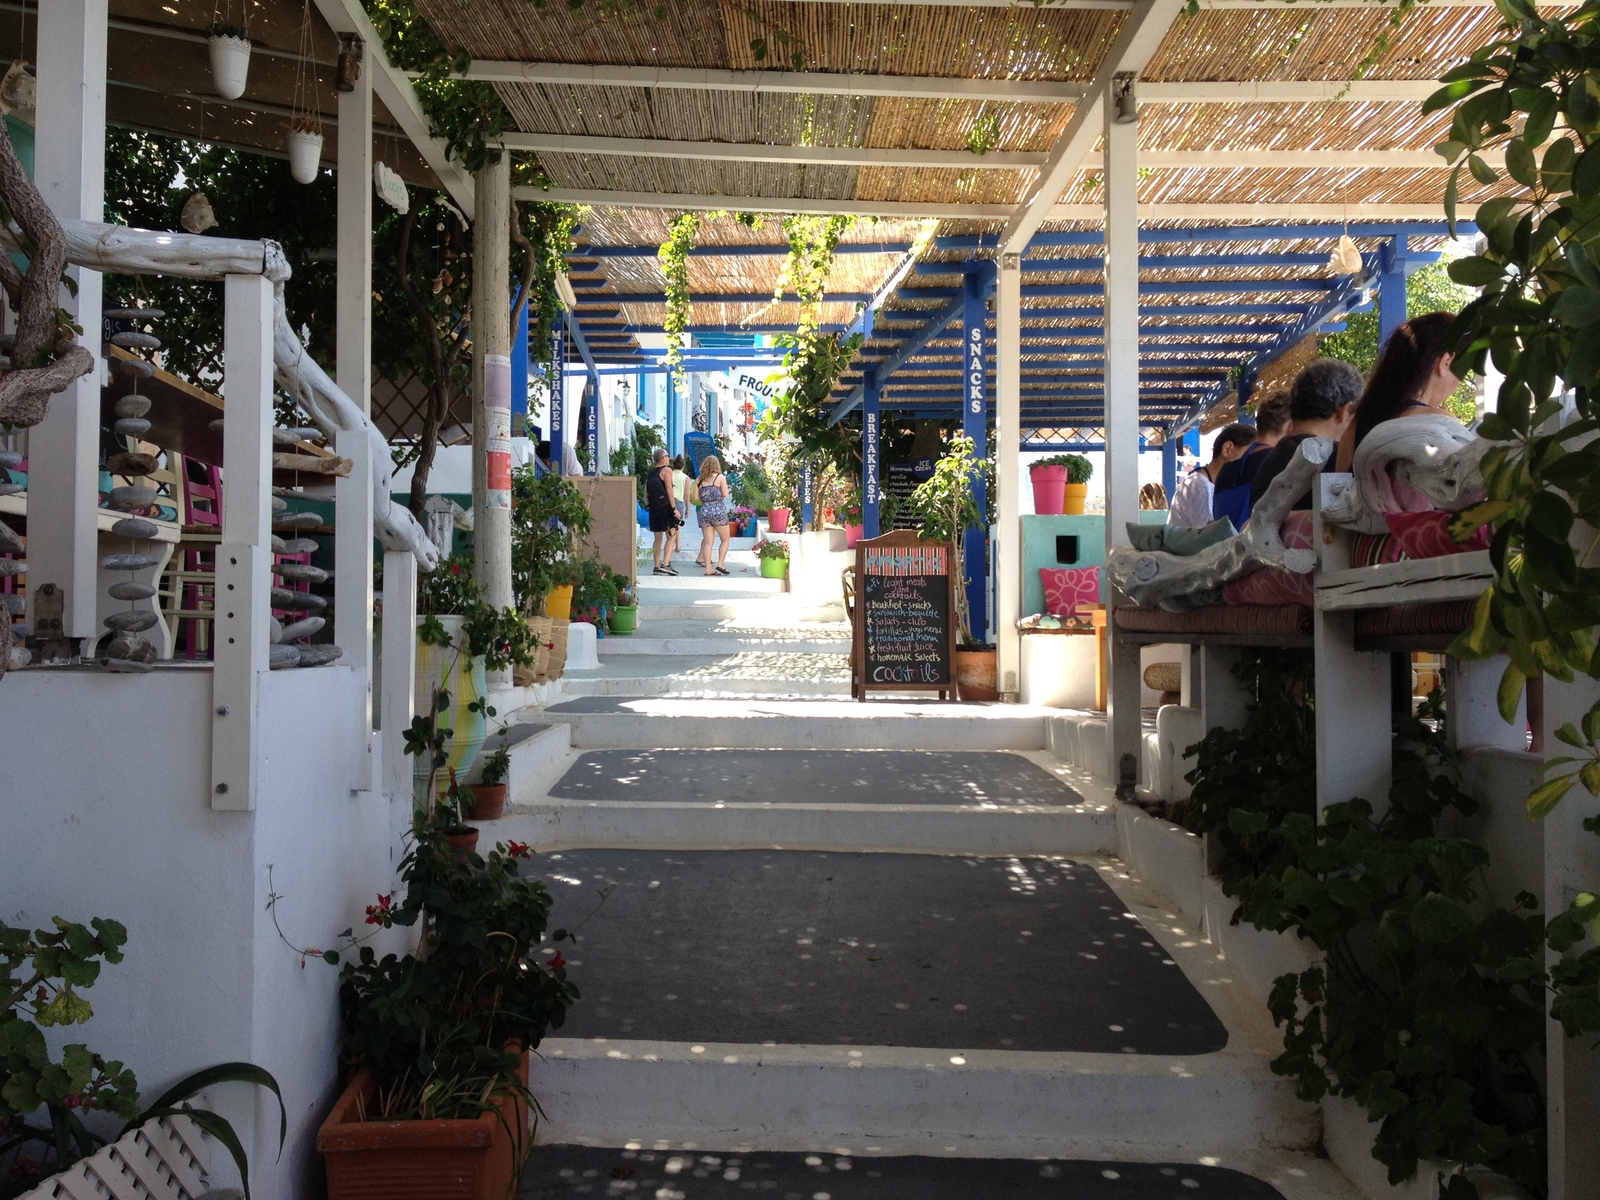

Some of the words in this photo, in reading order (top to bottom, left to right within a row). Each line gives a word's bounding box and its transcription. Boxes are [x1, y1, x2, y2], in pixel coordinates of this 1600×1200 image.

[551, 330, 561, 431] MILKSHAKES
[969, 327, 983, 413] SNACKS
[588, 406, 596, 430] ICE
[588, 433, 596, 473] CREAM
[867, 413, 877, 504] BREAKFAST
[883, 576, 903, 592] light
[906, 577, 927, 587] meals
[907, 617, 927, 626] club
[877, 653, 912, 662] homemade
